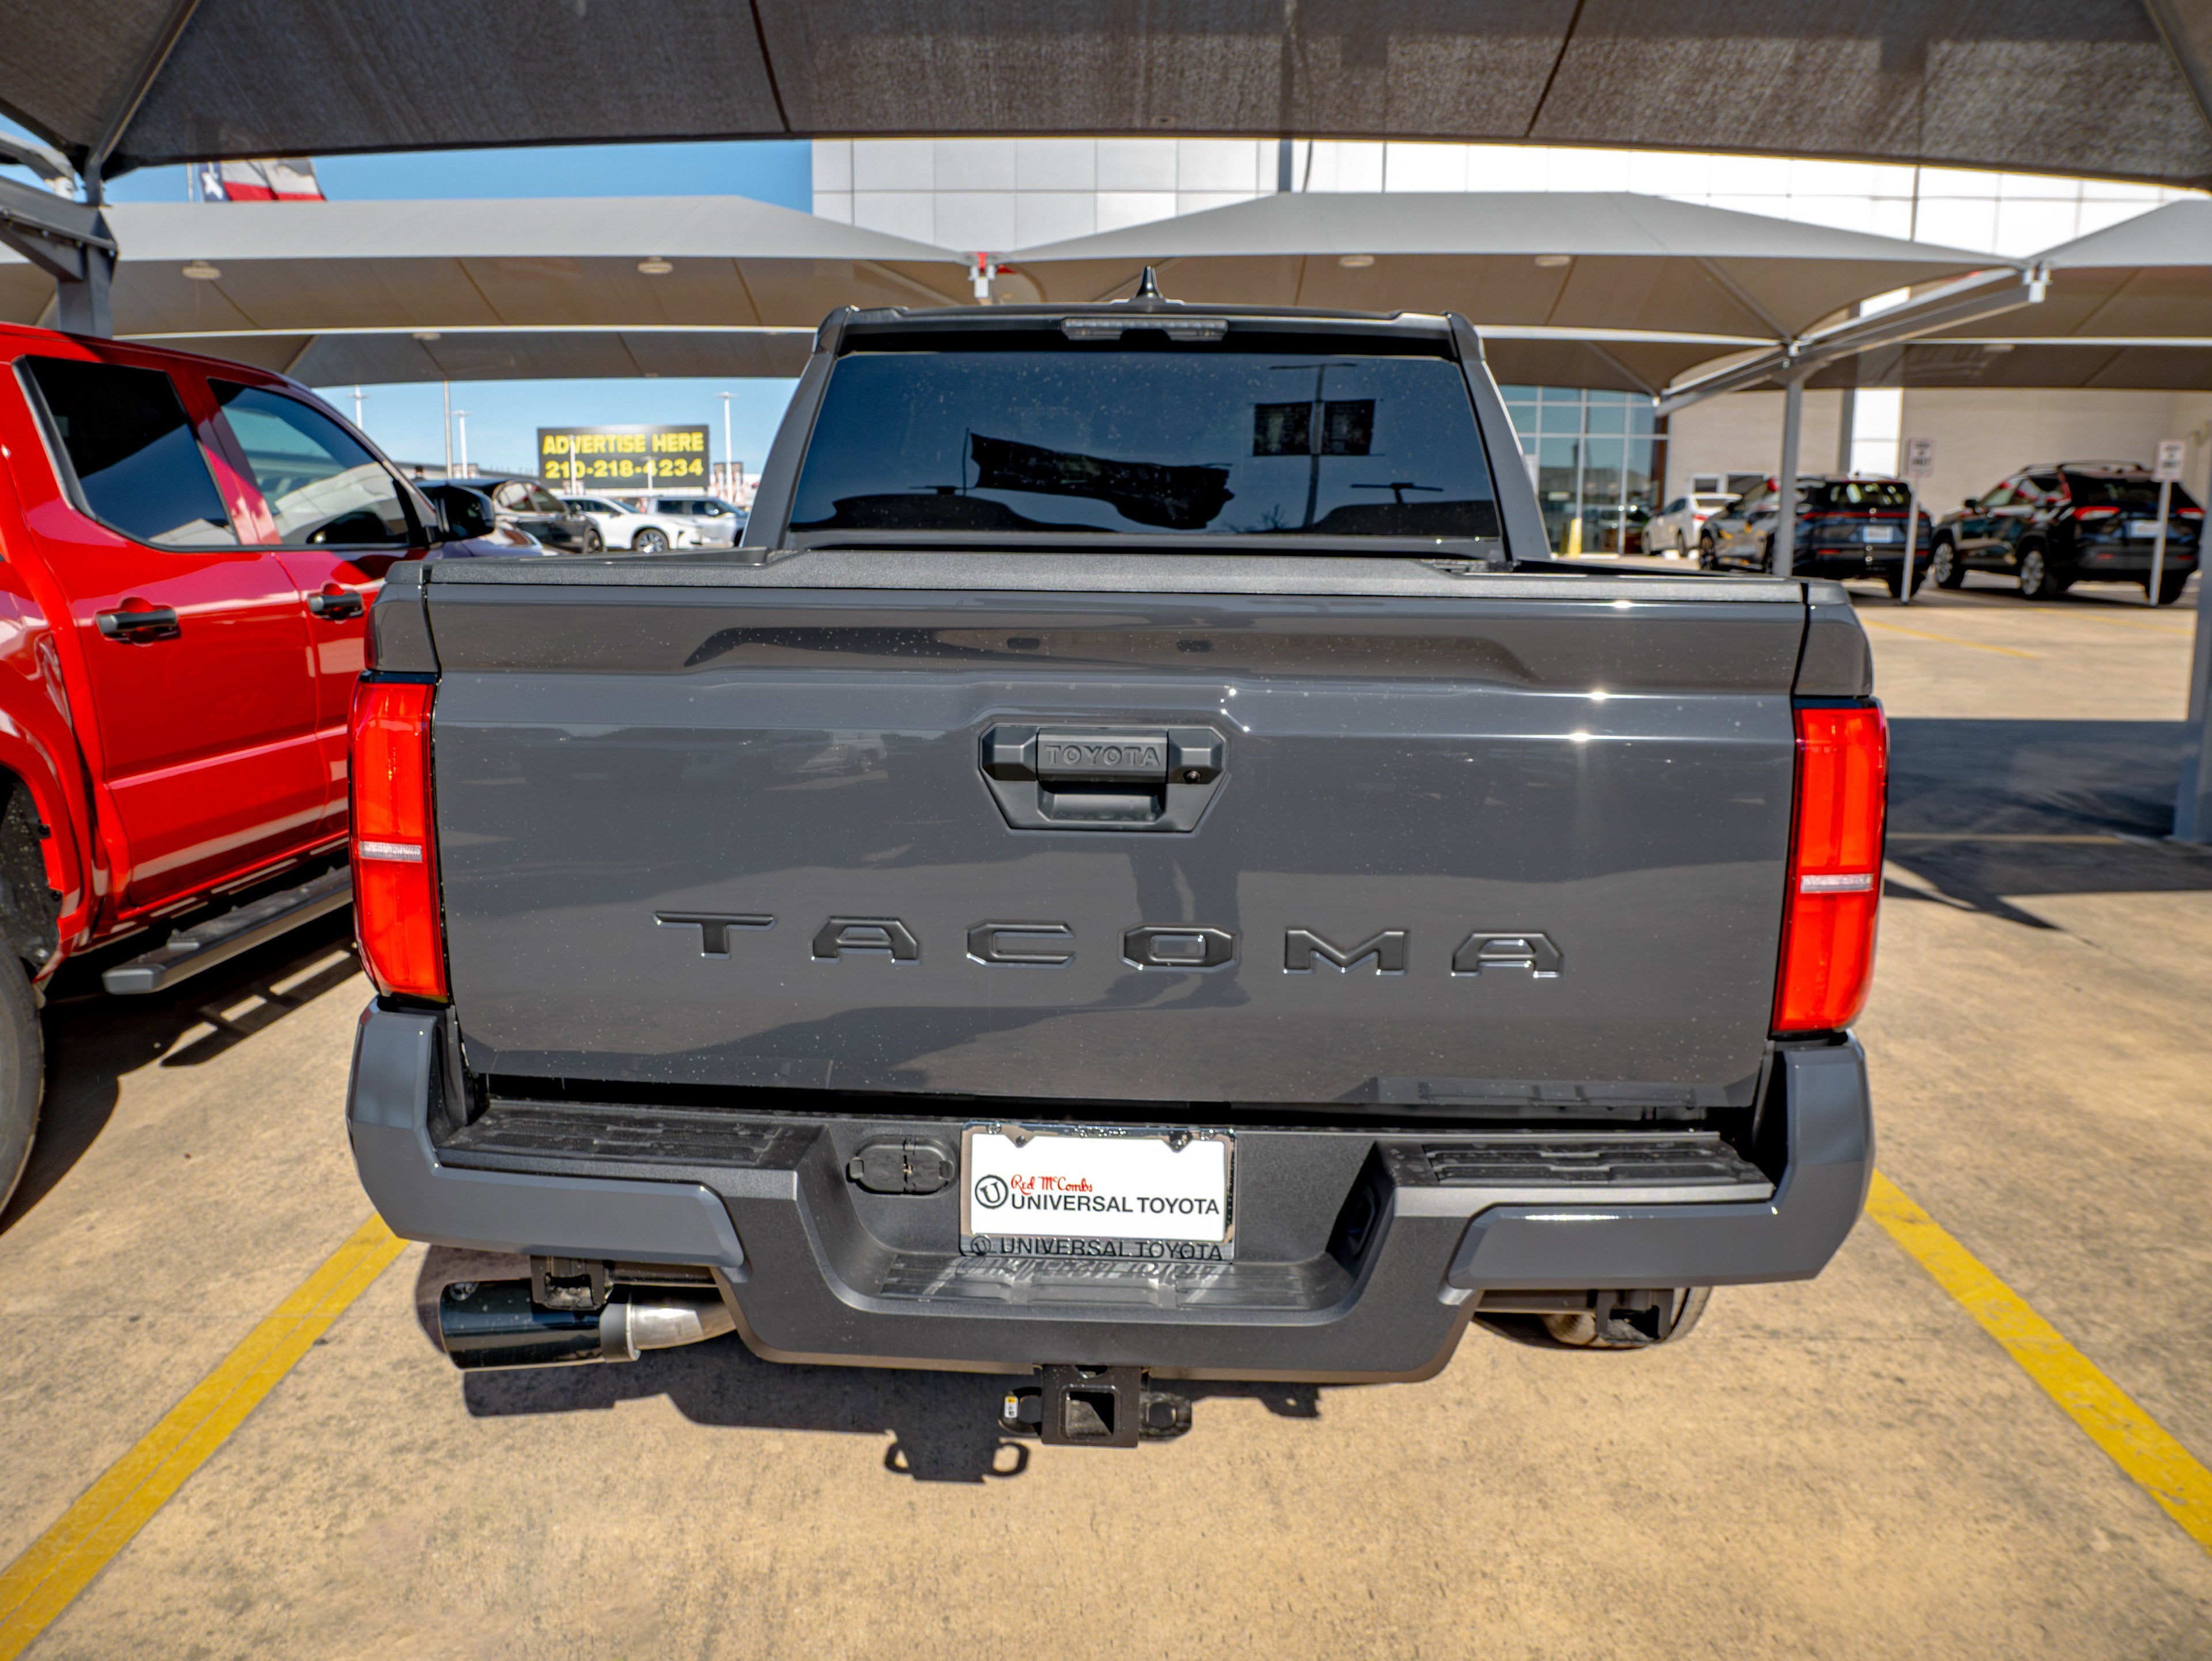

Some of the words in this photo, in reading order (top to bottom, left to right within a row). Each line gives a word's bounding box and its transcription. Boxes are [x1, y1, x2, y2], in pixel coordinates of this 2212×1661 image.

[542, 433, 646, 455] ADVERTISE
[652, 432, 704, 452] HERE
[545, 458, 703, 479] 210-218-4234
[1044, 745, 1161, 766] TOYOTA
[652, 911, 1566, 978] TACOMA
[1011, 1174, 1035, 1195] Red
[1038, 1176, 1093, 1193] McCombs
[1012, 1194, 1133, 1212] UNIVERSAL
[1137, 1197, 1219, 1214] TOYOTA
[1001, 1237, 1131, 1257] UNIVERSAL
[1136, 1241, 1224, 1261] TOYOTA
